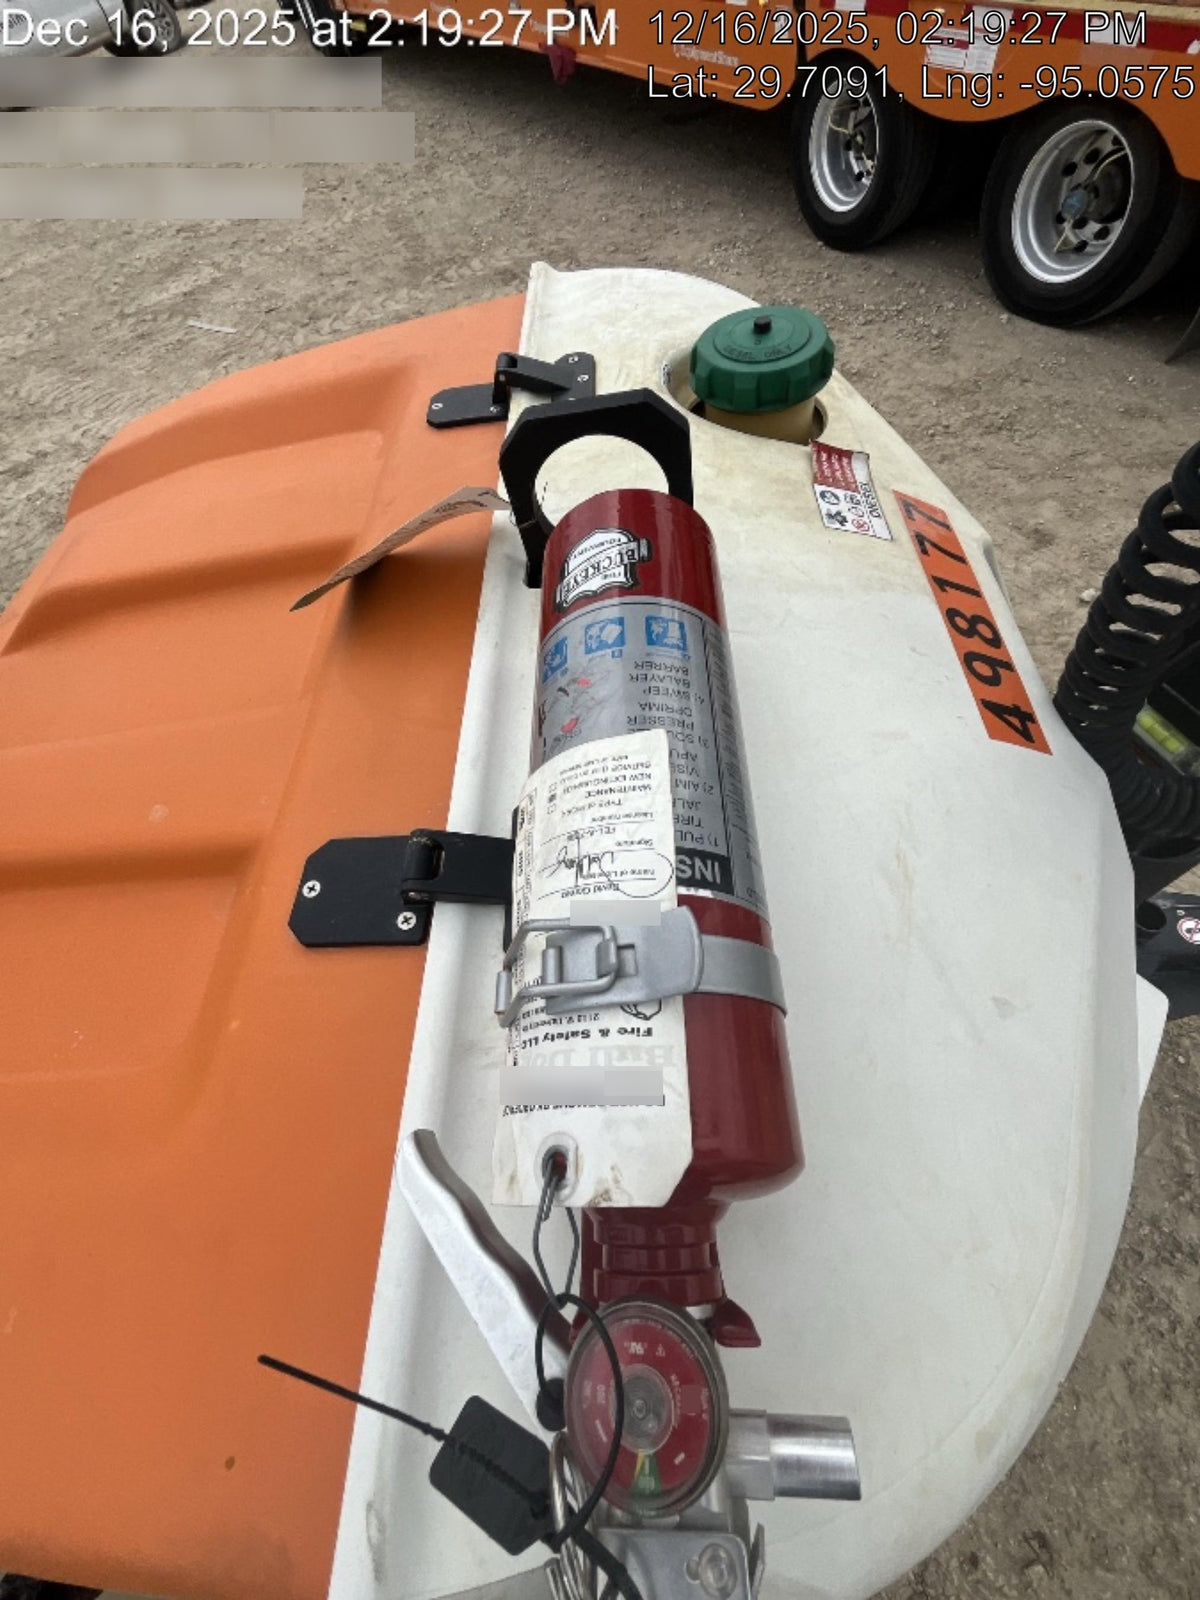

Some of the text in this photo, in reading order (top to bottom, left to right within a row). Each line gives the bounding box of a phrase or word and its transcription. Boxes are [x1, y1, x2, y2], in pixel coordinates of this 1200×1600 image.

[563, 549, 637, 597] BUCKEYE
[902, 500, 1036, 743] 498177
[633, 661, 689, 676] BARRER
[629, 673, 691, 688] BALAYER
[643, 686, 690, 701] SWEEP
[521, 1027, 653, 1049] Fire & Safety LLC
